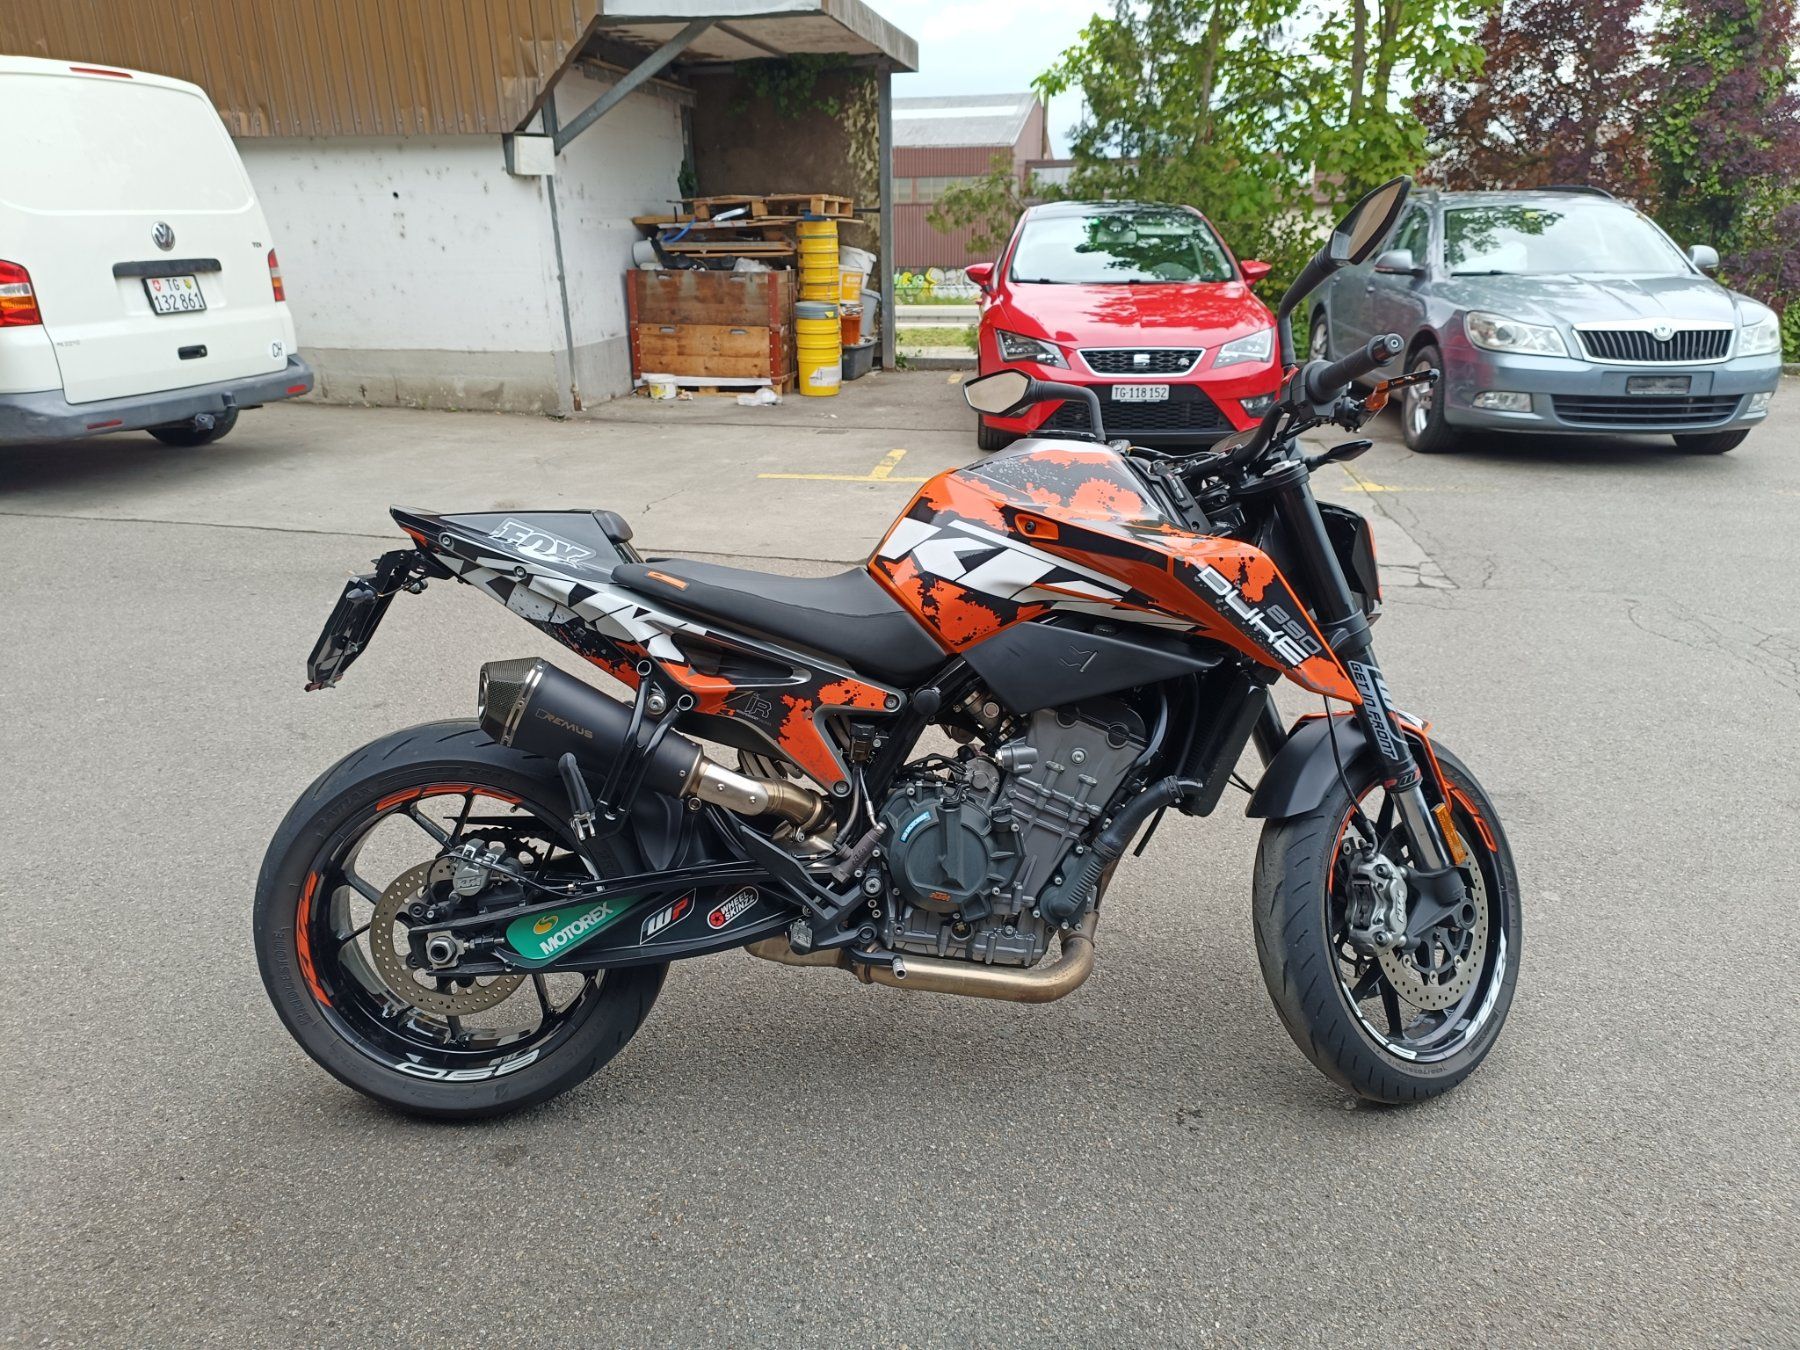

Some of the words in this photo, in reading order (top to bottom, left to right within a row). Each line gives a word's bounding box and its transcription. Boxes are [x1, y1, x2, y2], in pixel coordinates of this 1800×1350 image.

[165, 279, 180, 291] TG
[487, 520, 592, 568] FOX
[1198, 566, 1309, 666] DUKE
[1266, 604, 1322, 655] 890
[536, 708, 593, 739] REMUS
[1350, 662, 1370, 690] GET
[1368, 709, 1397, 760] FRONT
[720, 891, 749, 915] WHEEL
[539, 901, 613, 955] MOTOREX
